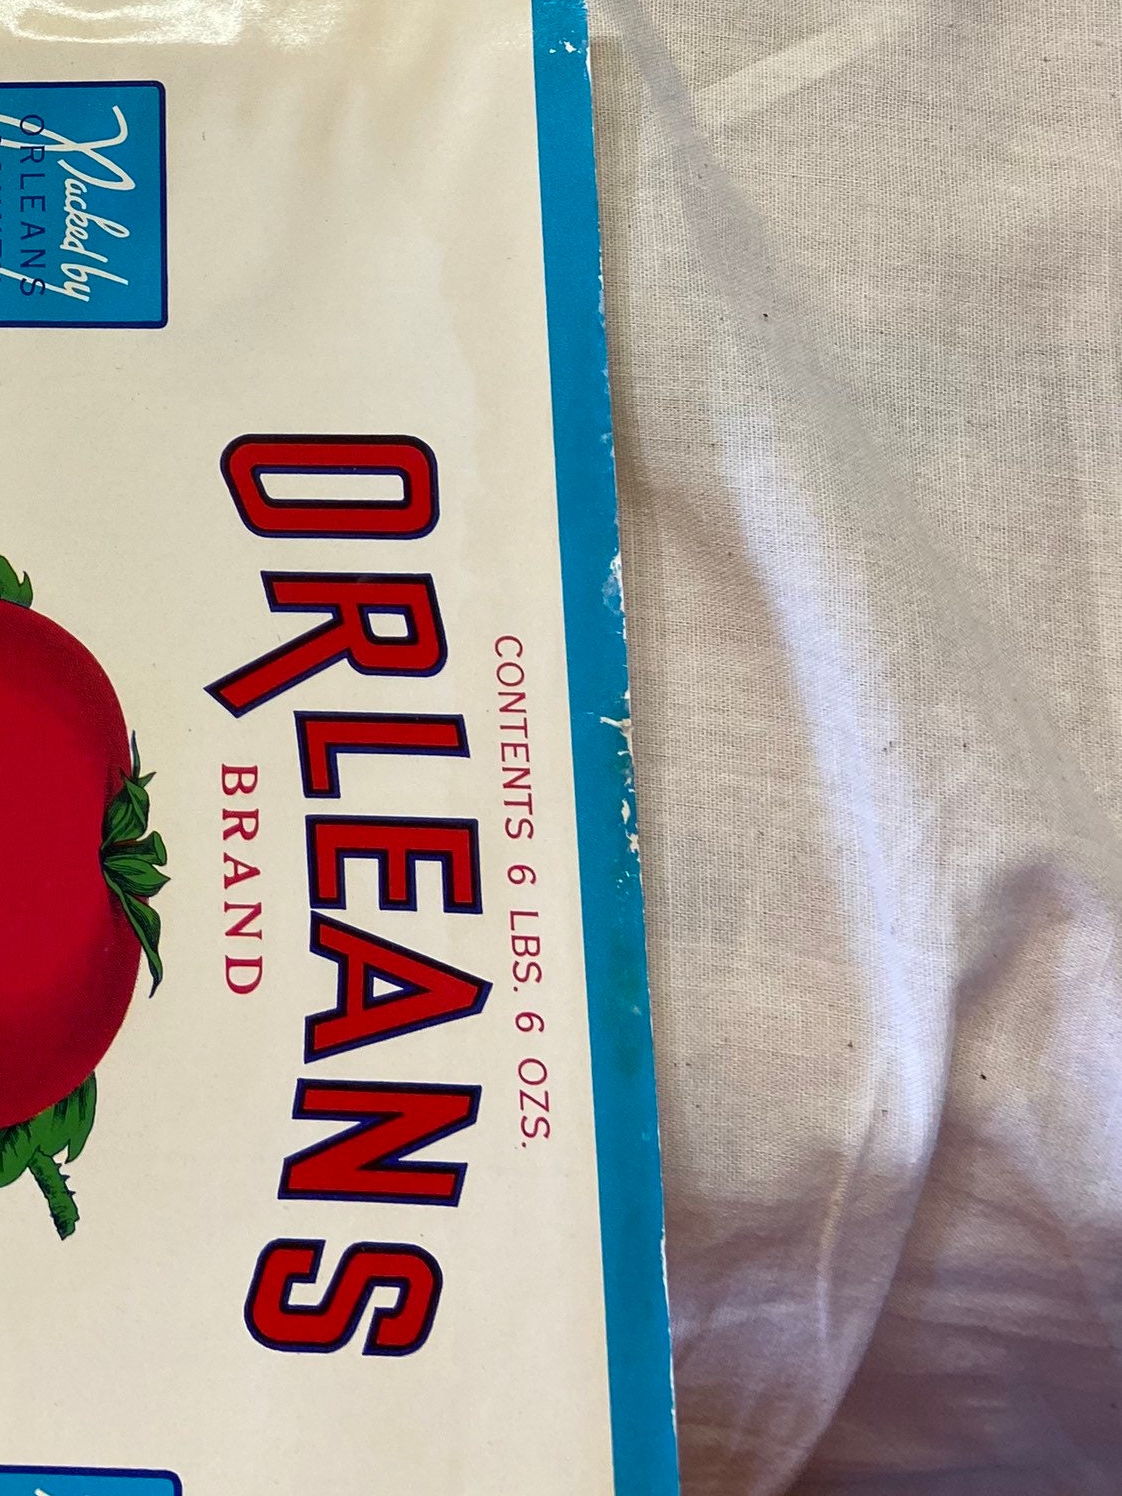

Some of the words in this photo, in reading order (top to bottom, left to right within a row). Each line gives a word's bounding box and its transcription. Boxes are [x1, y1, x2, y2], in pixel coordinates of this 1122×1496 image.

[19, 113, 46, 297] ORLEANS
[493, 634, 535, 840] CONTENTS
[203, 433, 494, 1357] ORLEANS
[220, 762, 264, 995] BRAND
[507, 863, 537, 886] 6
[509, 909, 543, 993] LBS.
[514, 1011, 545, 1034] 6
[517, 1058, 551, 1149] OZS.
